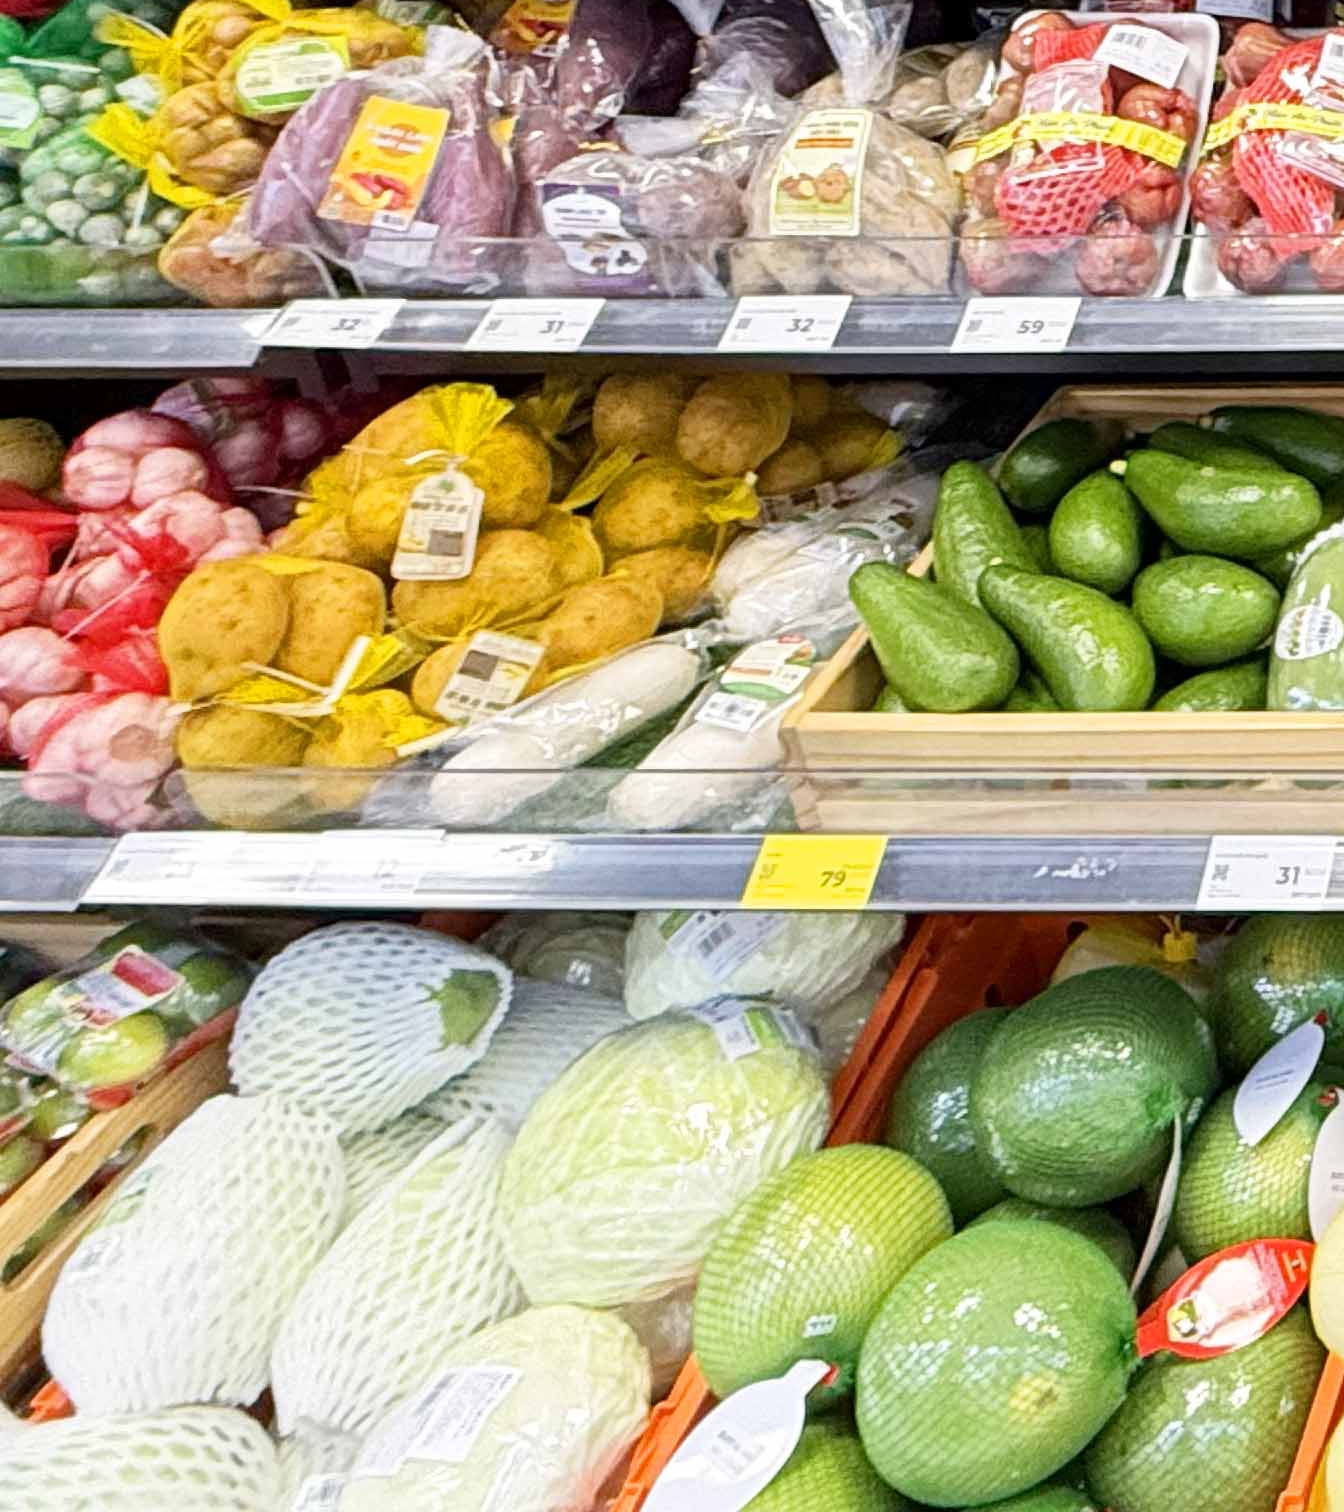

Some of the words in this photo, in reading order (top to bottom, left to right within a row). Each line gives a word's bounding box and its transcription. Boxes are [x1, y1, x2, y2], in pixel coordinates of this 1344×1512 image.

[540, 320, 564, 334] 31
[786, 318, 814, 332] 32
[1017, 320, 1044, 334] 59
[820, 870, 847, 887] 79
[1275, 866, 1300, 885] 31
